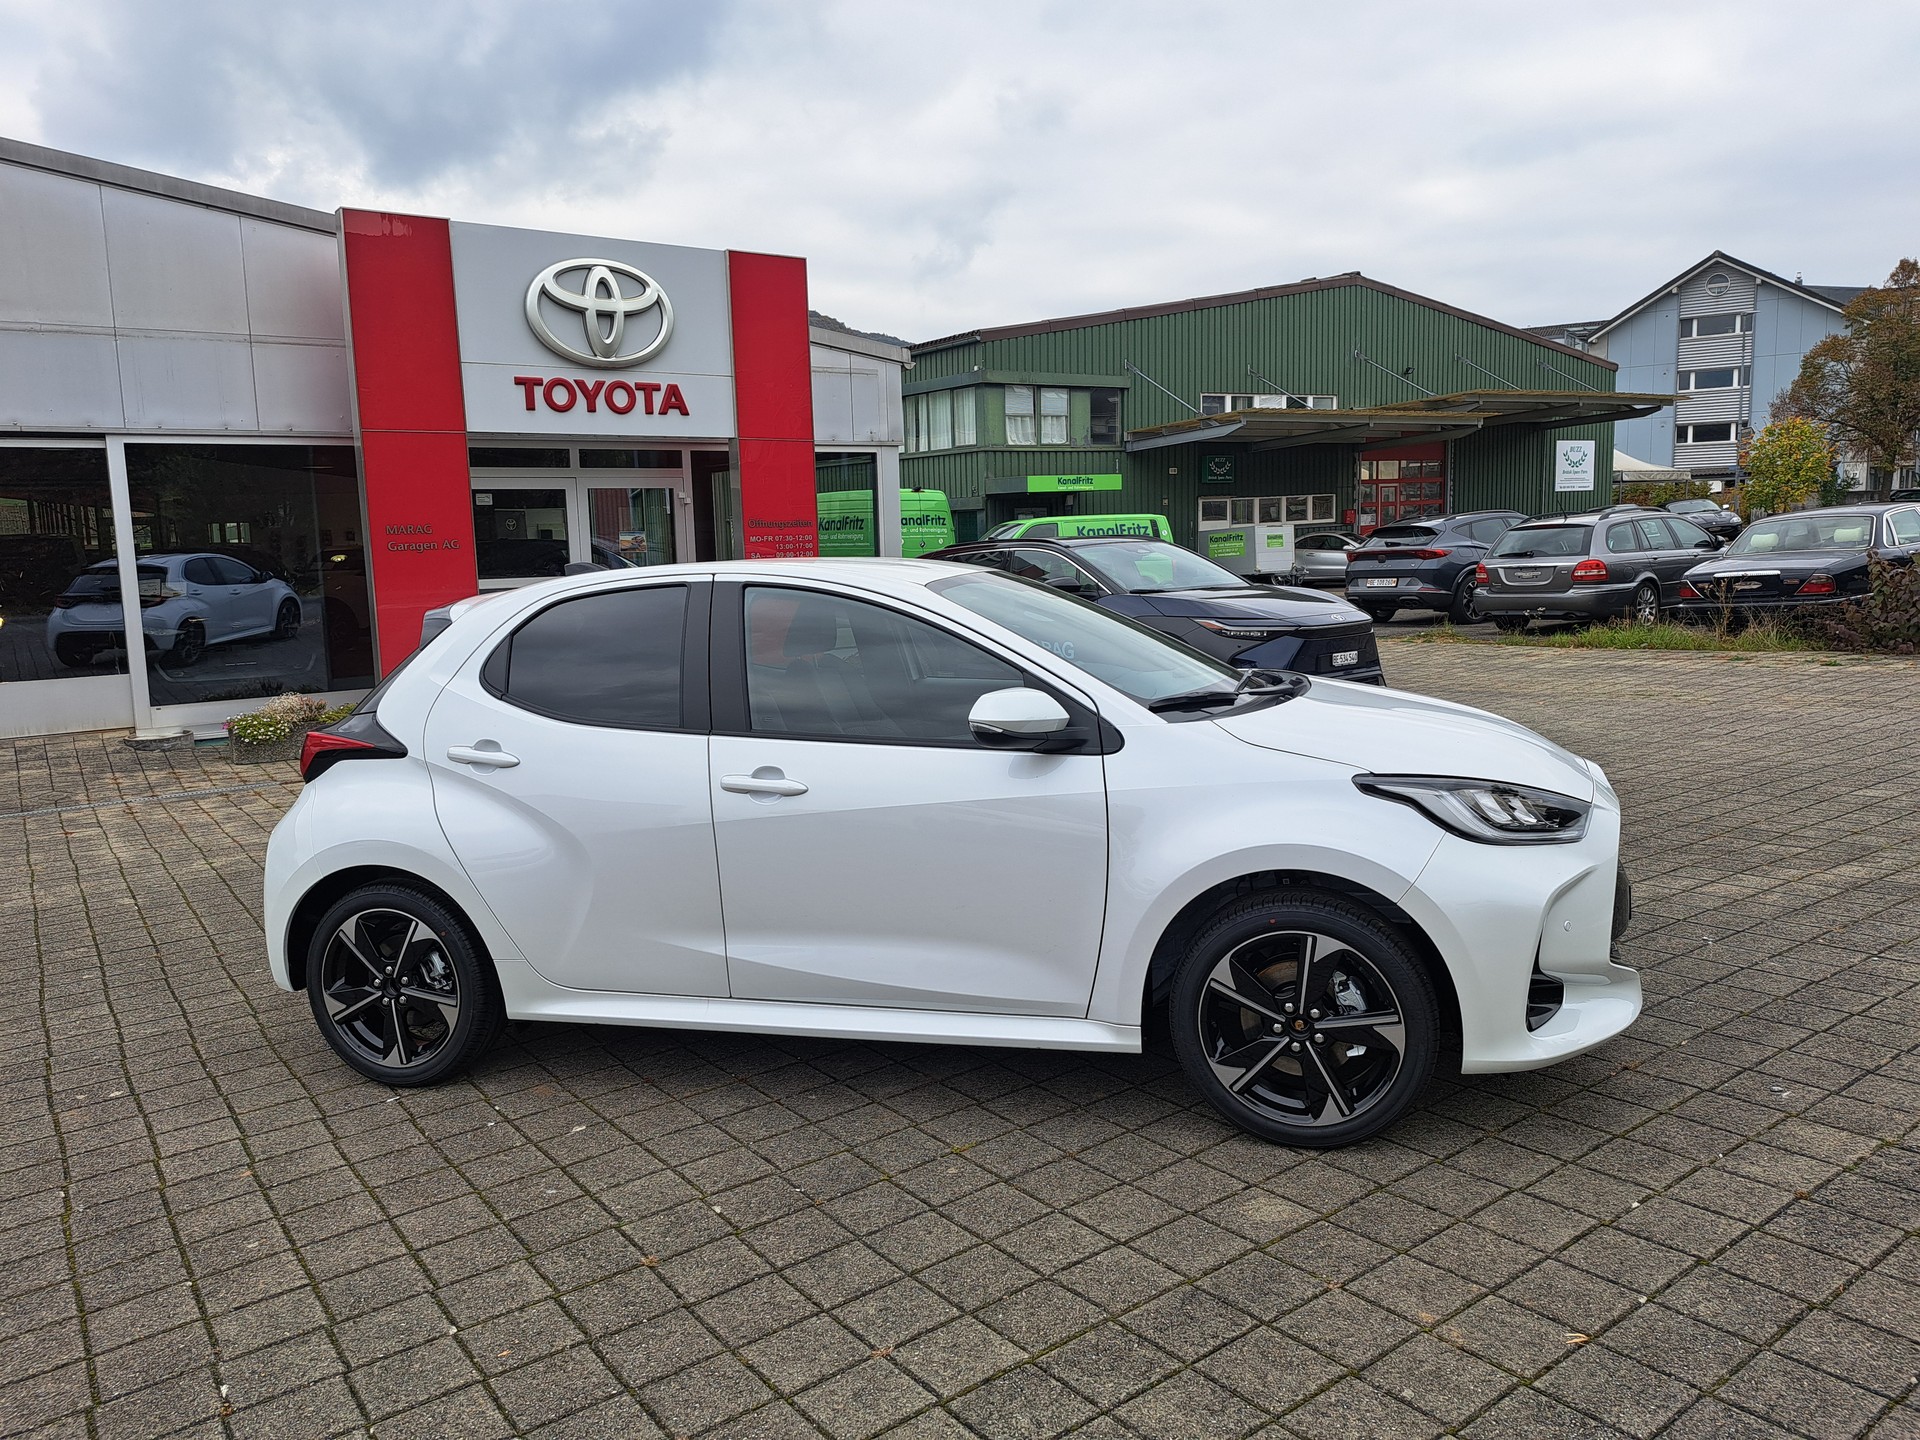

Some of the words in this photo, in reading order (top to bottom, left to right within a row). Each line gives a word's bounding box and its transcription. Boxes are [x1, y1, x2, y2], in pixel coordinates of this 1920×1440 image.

[514, 376, 690, 416] TOYOTA
[1057, 476, 1093, 485] KanalFritz
[818, 514, 864, 531] KanalFritz
[901, 513, 946, 527] analFritz
[386, 524, 432, 535] MARAG
[1076, 522, 1150, 536] KanalFritz
[1209, 533, 1244, 543] KanalFritz
[388, 540, 438, 553] Garagen
[442, 539, 460, 550] AG
